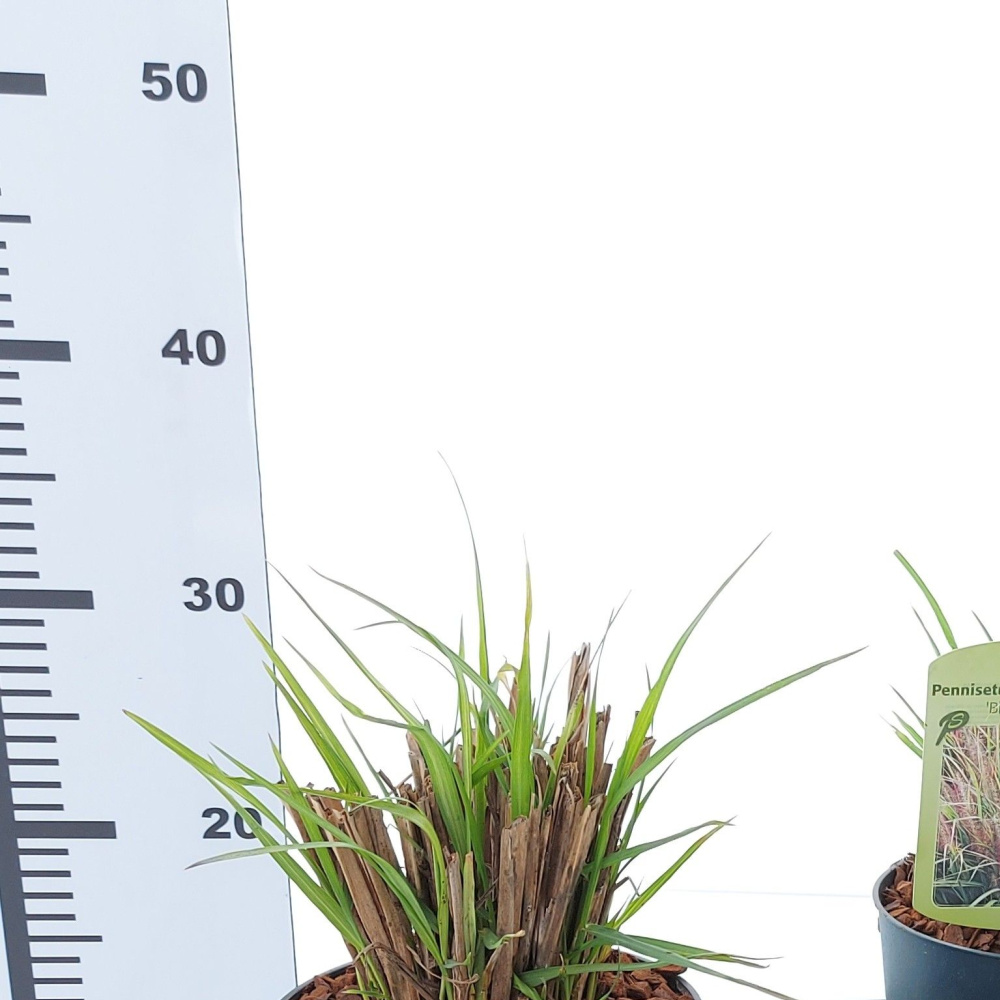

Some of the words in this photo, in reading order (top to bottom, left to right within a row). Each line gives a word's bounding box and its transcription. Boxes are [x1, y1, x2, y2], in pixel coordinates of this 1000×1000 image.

[141, 61, 208, 103] 50
[161, 329, 226, 367] 40
[183, 577, 245, 613] 30
[202, 807, 263, 841] 20
